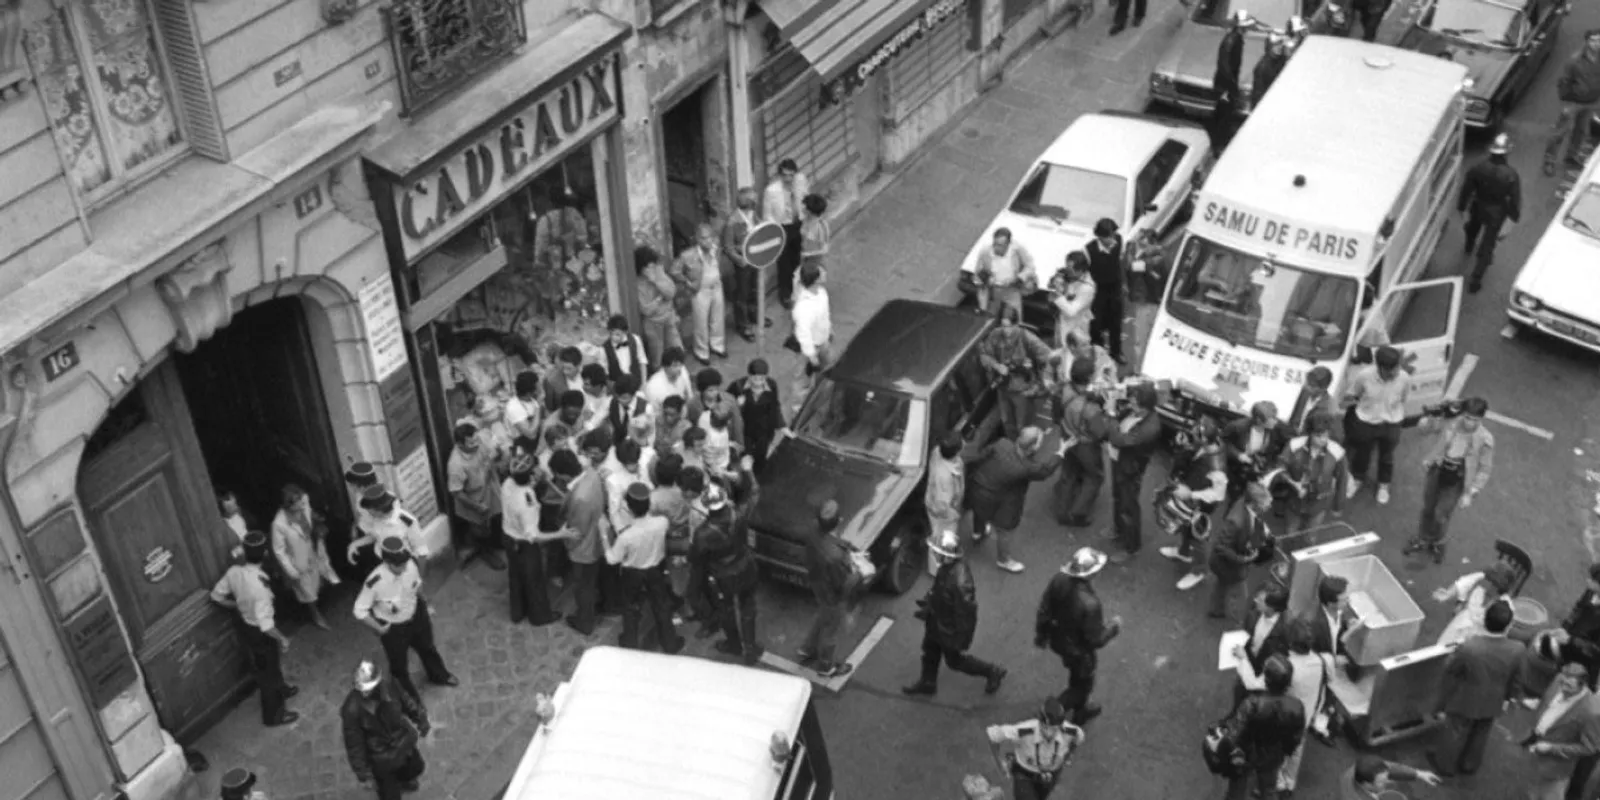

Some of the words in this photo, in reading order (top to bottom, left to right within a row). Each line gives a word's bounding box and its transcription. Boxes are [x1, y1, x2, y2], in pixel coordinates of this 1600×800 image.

[402, 61, 614, 240] CADEAUX
[1203, 201, 1258, 235] SAMU
[1263, 220, 1290, 246] DE
[1293, 231, 1360, 260] PARIS
[49, 349, 71, 377] 16
[1161, 328, 1209, 360] POLICE
[1212, 350, 1279, 380] SECOURS
